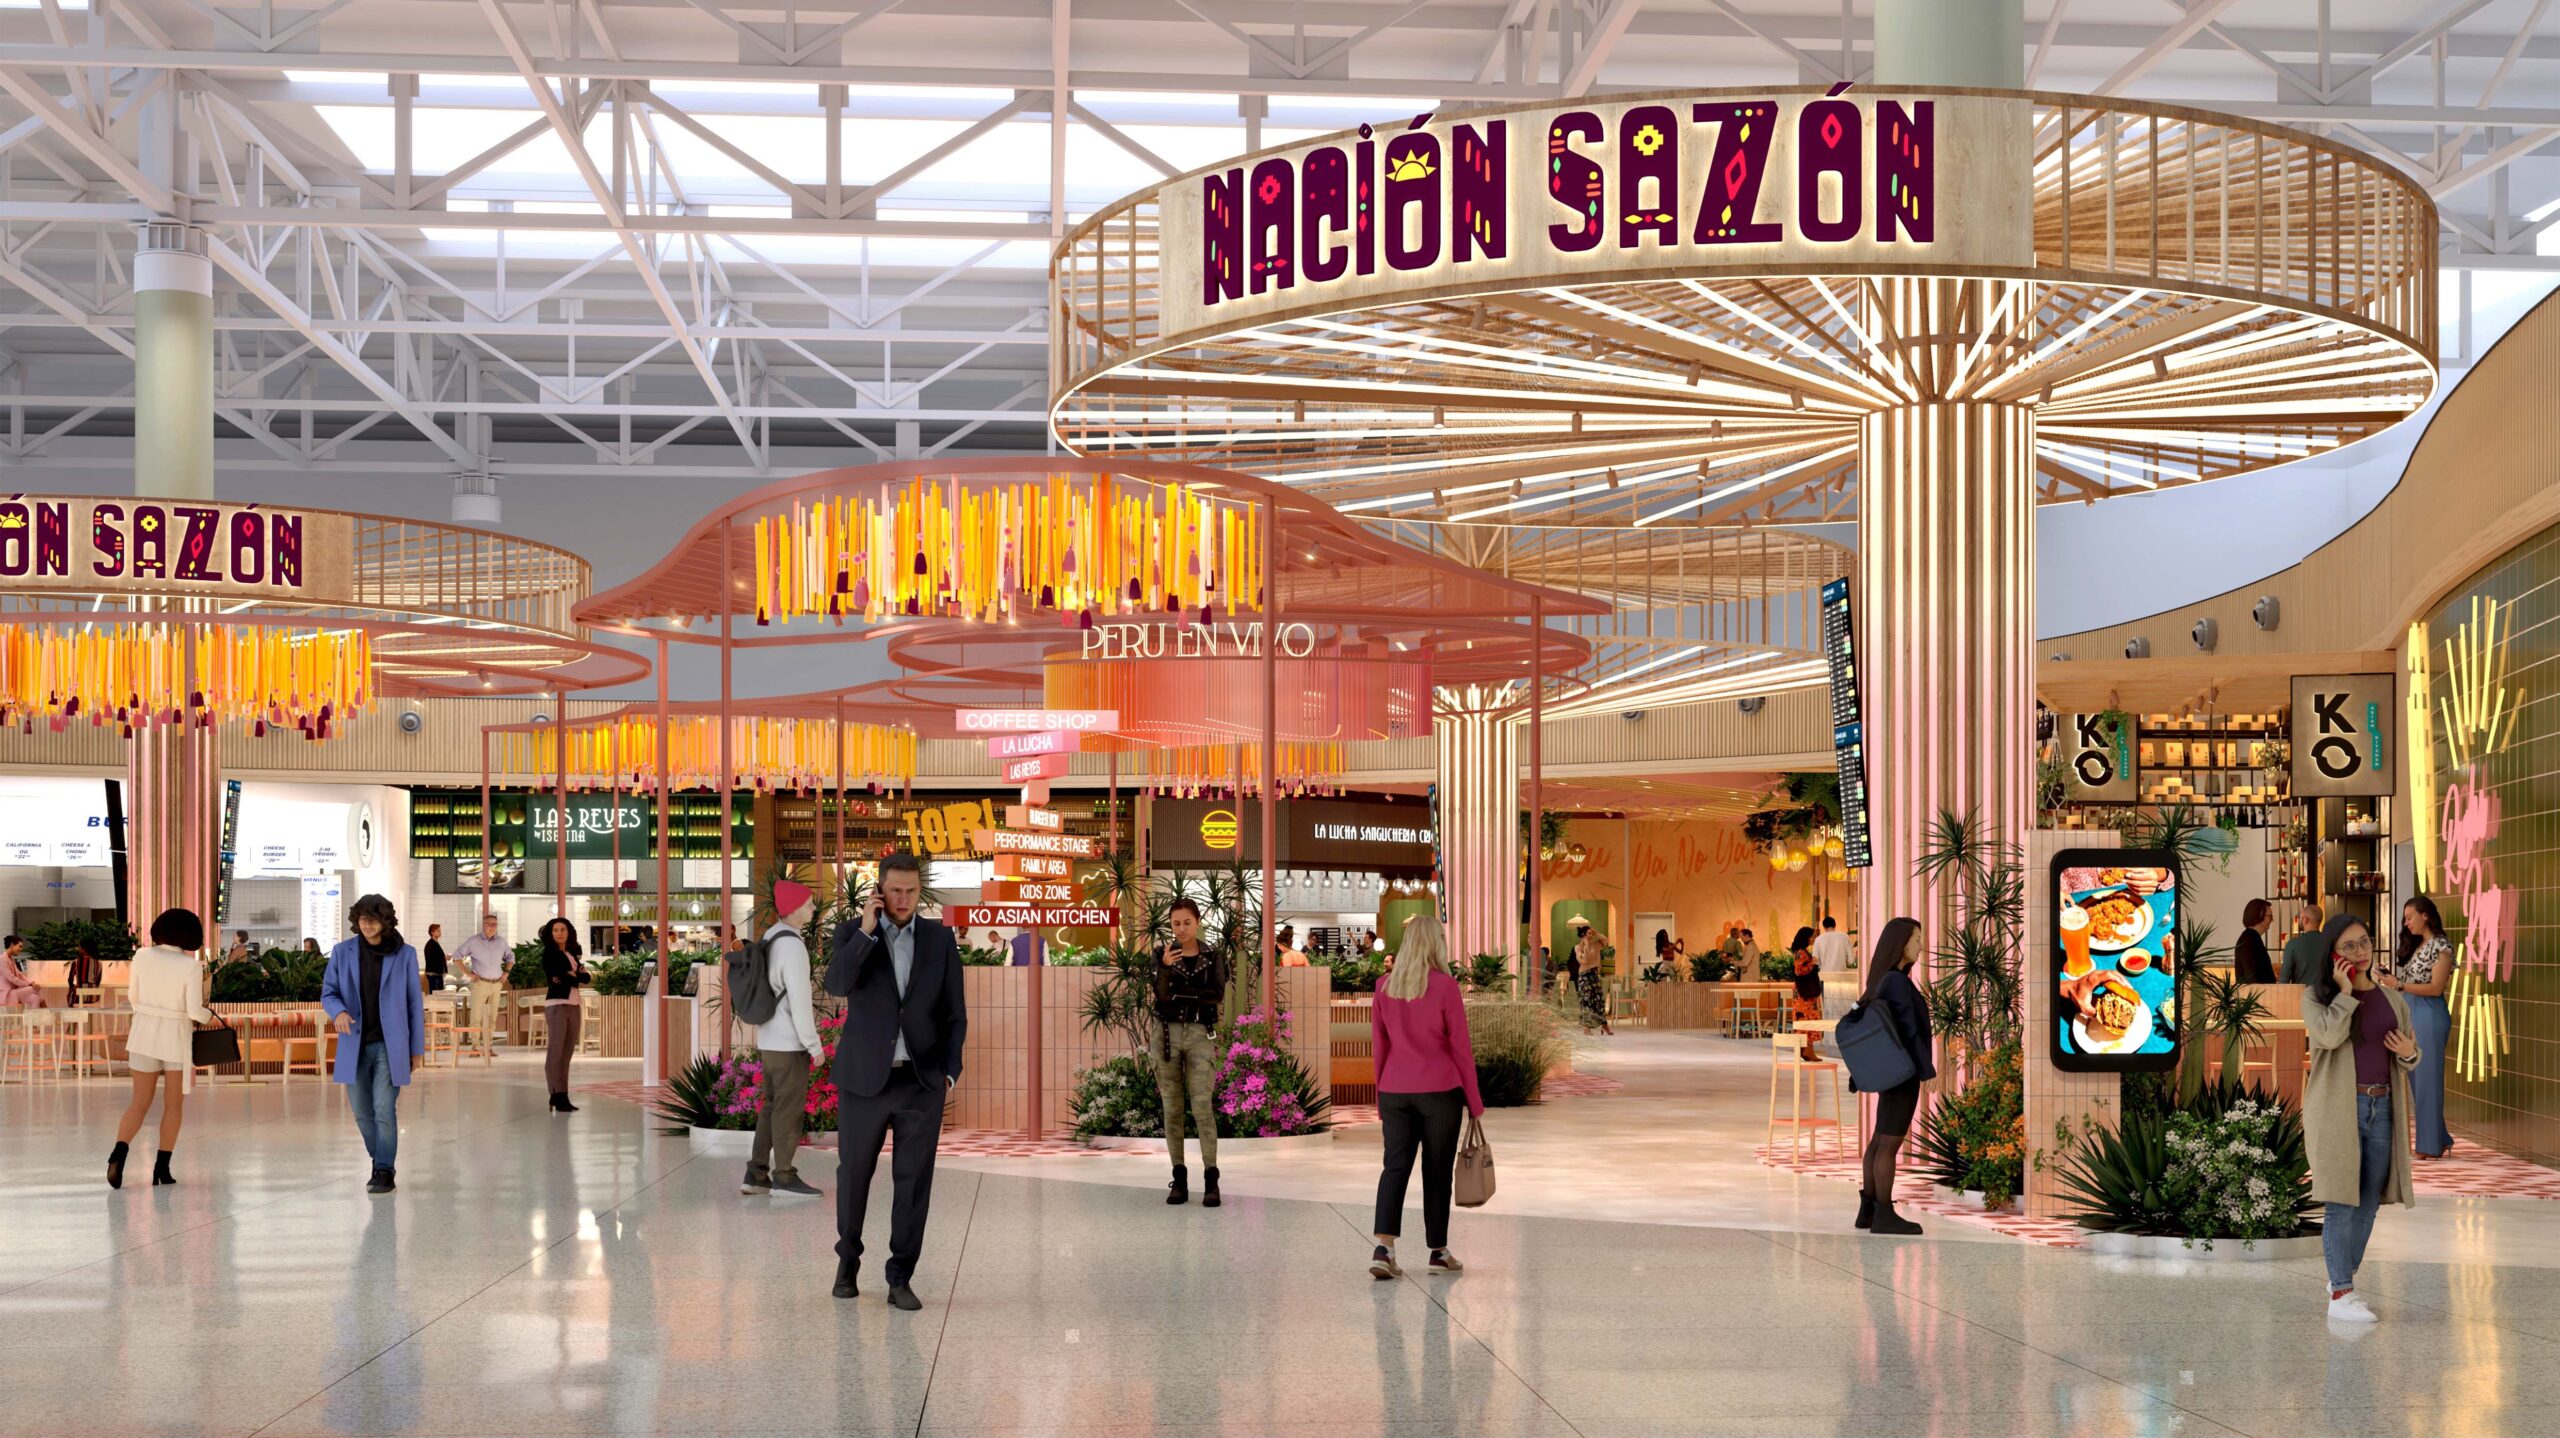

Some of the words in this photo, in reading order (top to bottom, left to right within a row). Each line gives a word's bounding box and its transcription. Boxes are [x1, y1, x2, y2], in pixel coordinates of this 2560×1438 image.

[1202, 112, 1508, 307] NACIÓN
[1548, 81, 1935, 252] SAZÓN
[93, 503, 303, 587] SAZÓN
[1081, 623, 1167, 659] PERU
[1176, 622, 1218, 657] EN
[965, 713, 1040, 728] COFFEE
[1045, 713, 1097, 728] SHOP
[1003, 739, 1016, 754] LA
[1018, 735, 1053, 752] LUCHA
[2311, 693, 2361, 779] KO
[1010, 764, 1021, 780] LAS
[1021, 760, 1041, 778] REYES
[534, 808, 573, 828] LAS
[578, 808, 641, 834] REYES
[541, 829, 586, 842] ISINA
[1314, 823, 1326, 838] LA
[1329, 824, 1357, 840] LUCHA
[994, 832, 1061, 852] PERFORMANCE
[1062, 837, 1090, 854] STAGE
[1020, 858, 1047, 874] FAMILY
[1048, 859, 1067, 875] AREA
[1677, 835, 1708, 882] No
[1020, 884, 1043, 899] KIDS
[1044, 885, 1071, 900] ZONE
[969, 909, 991, 924] KO
[995, 909, 1041, 924] ASIAN
[1046, 910, 1110, 925] KITCHEN
